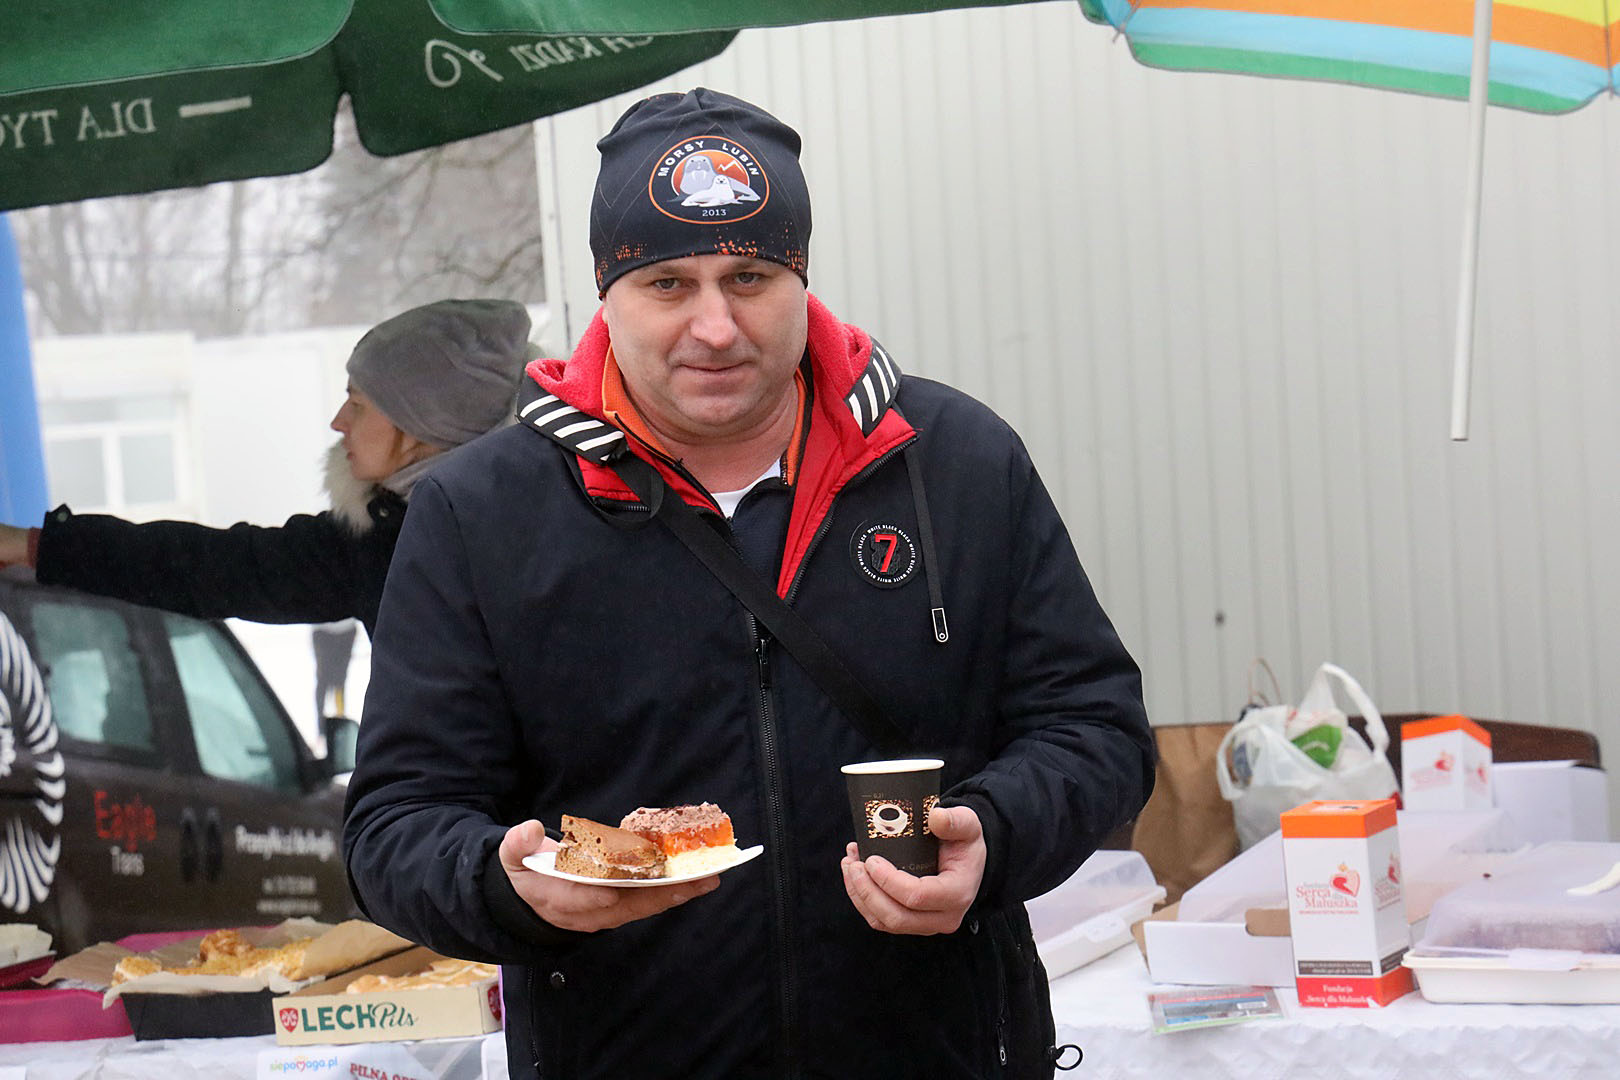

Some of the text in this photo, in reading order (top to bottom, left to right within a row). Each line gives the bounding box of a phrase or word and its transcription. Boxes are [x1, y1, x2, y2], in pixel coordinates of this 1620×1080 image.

[657, 140, 760, 178] MORSY LUBIN
[701, 208, 727, 218] 2013
[875, 533, 897, 572] 7
[301, 1001, 419, 1032] LECH Pils
[349, 1062, 389, 1080] PILNA
